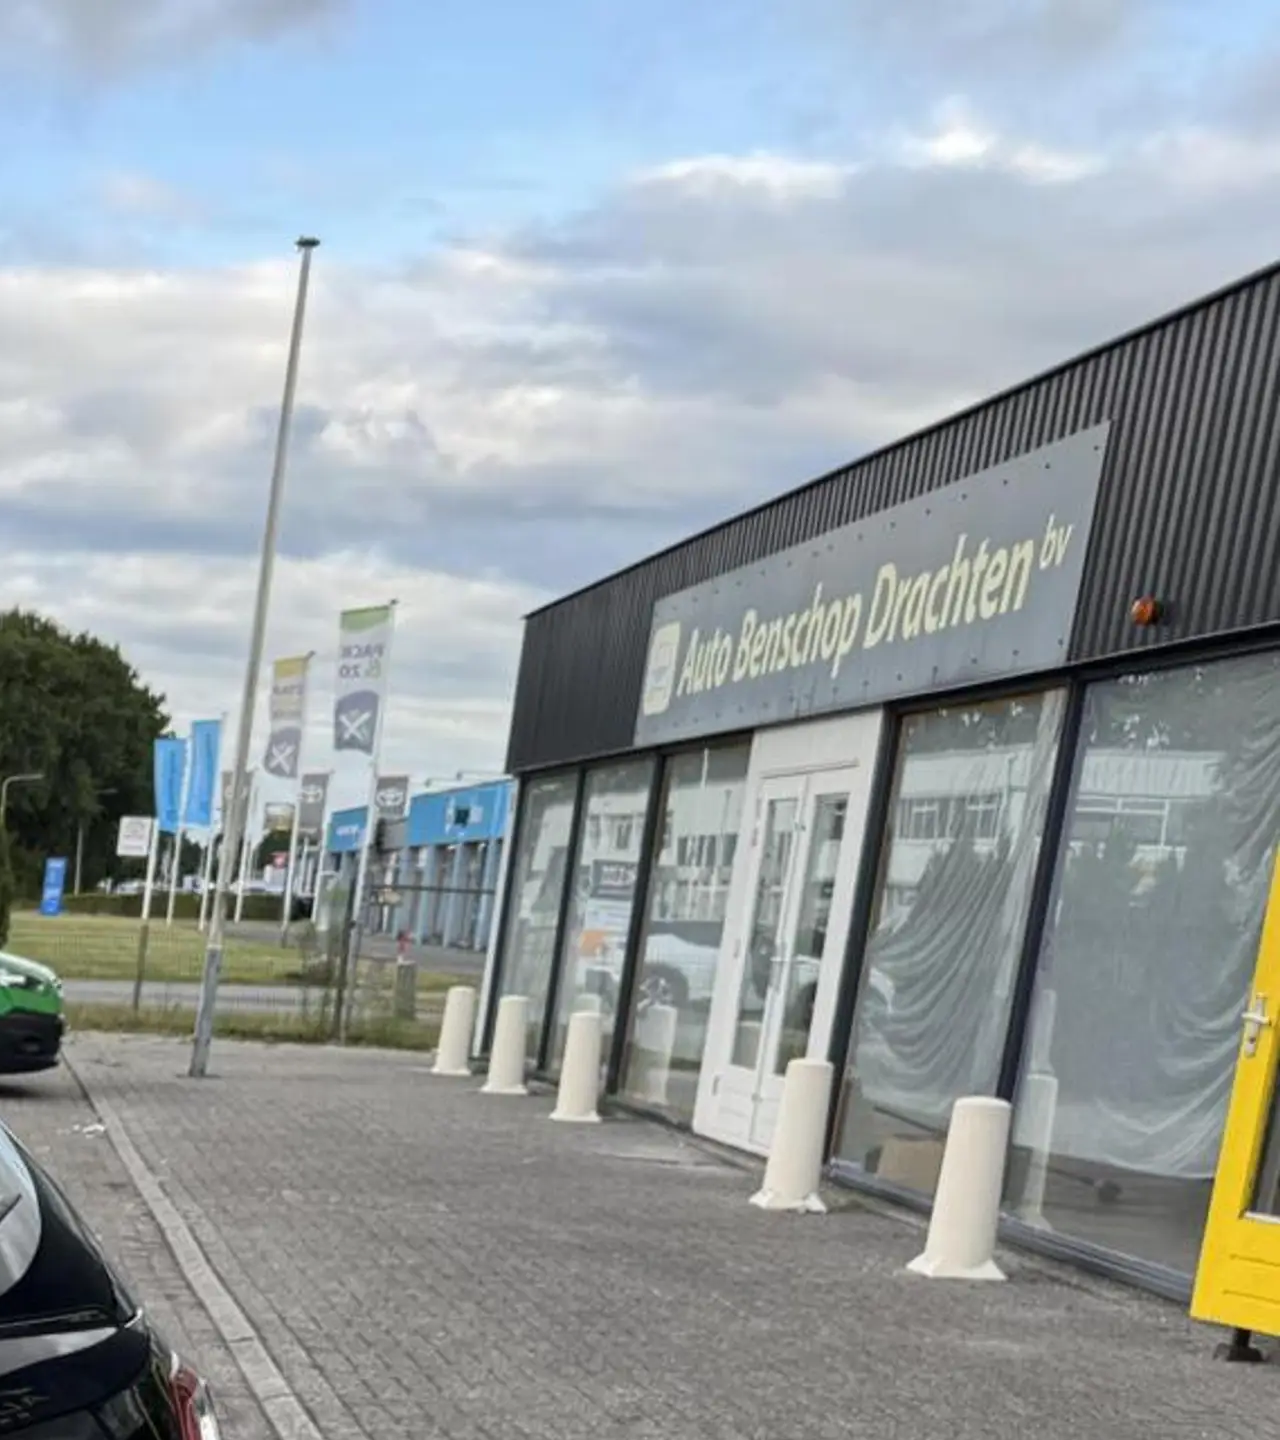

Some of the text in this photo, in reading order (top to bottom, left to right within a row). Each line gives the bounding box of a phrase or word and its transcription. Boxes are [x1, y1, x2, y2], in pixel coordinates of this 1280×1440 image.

[676, 514, 1075, 697] Auto Benschop Drachten bv
